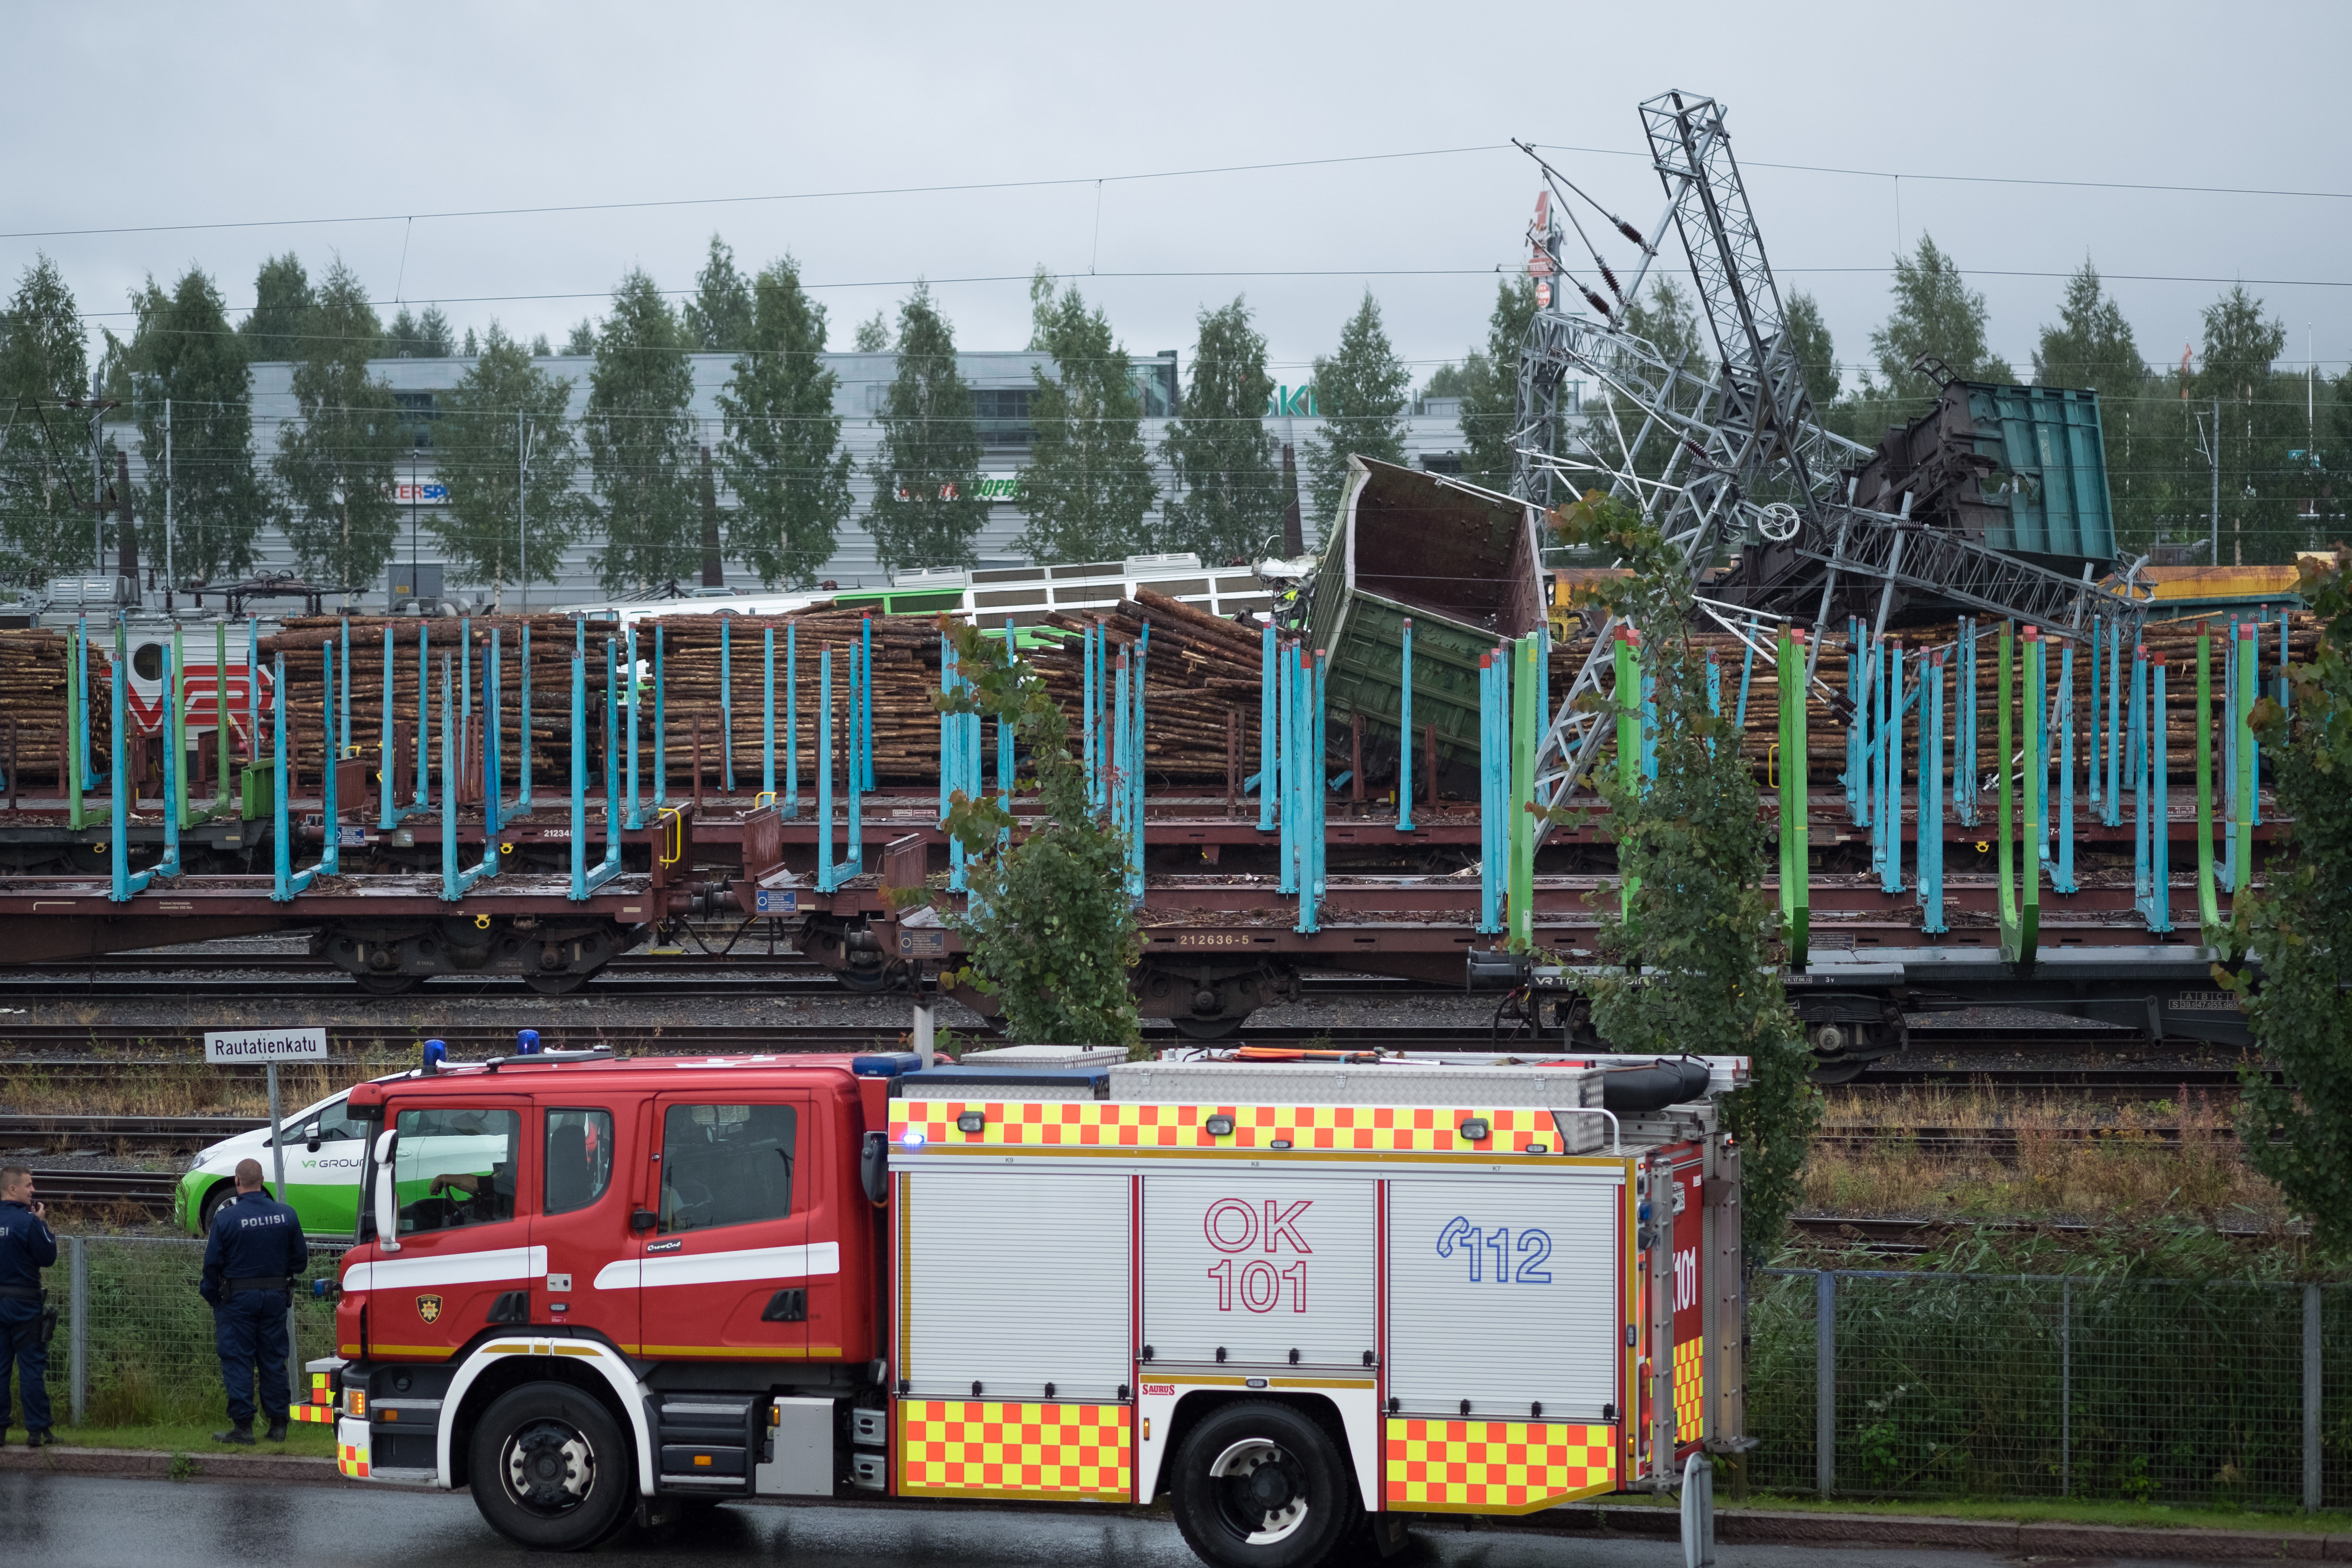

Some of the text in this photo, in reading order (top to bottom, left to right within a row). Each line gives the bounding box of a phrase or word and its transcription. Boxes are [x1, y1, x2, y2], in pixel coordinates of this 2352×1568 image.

[1529, 649, 1537, 662] 2
[100, 665, 273, 738] VR
[544, 829, 572, 837] 21234
[1180, 934, 1250, 945] 212636-5
[1535, 977, 1553, 985] VR
[215, 1036, 317, 1056] Rautatienkatu
[301, 1160, 317, 1168] VR
[241, 1214, 285, 1228] POLIISI
[1204, 1198, 1314, 1254] OK
[0, 1226, 9, 1236] SI
[1459, 1227, 1552, 1284] 112
[1208, 1259, 1306, 1313] 101
